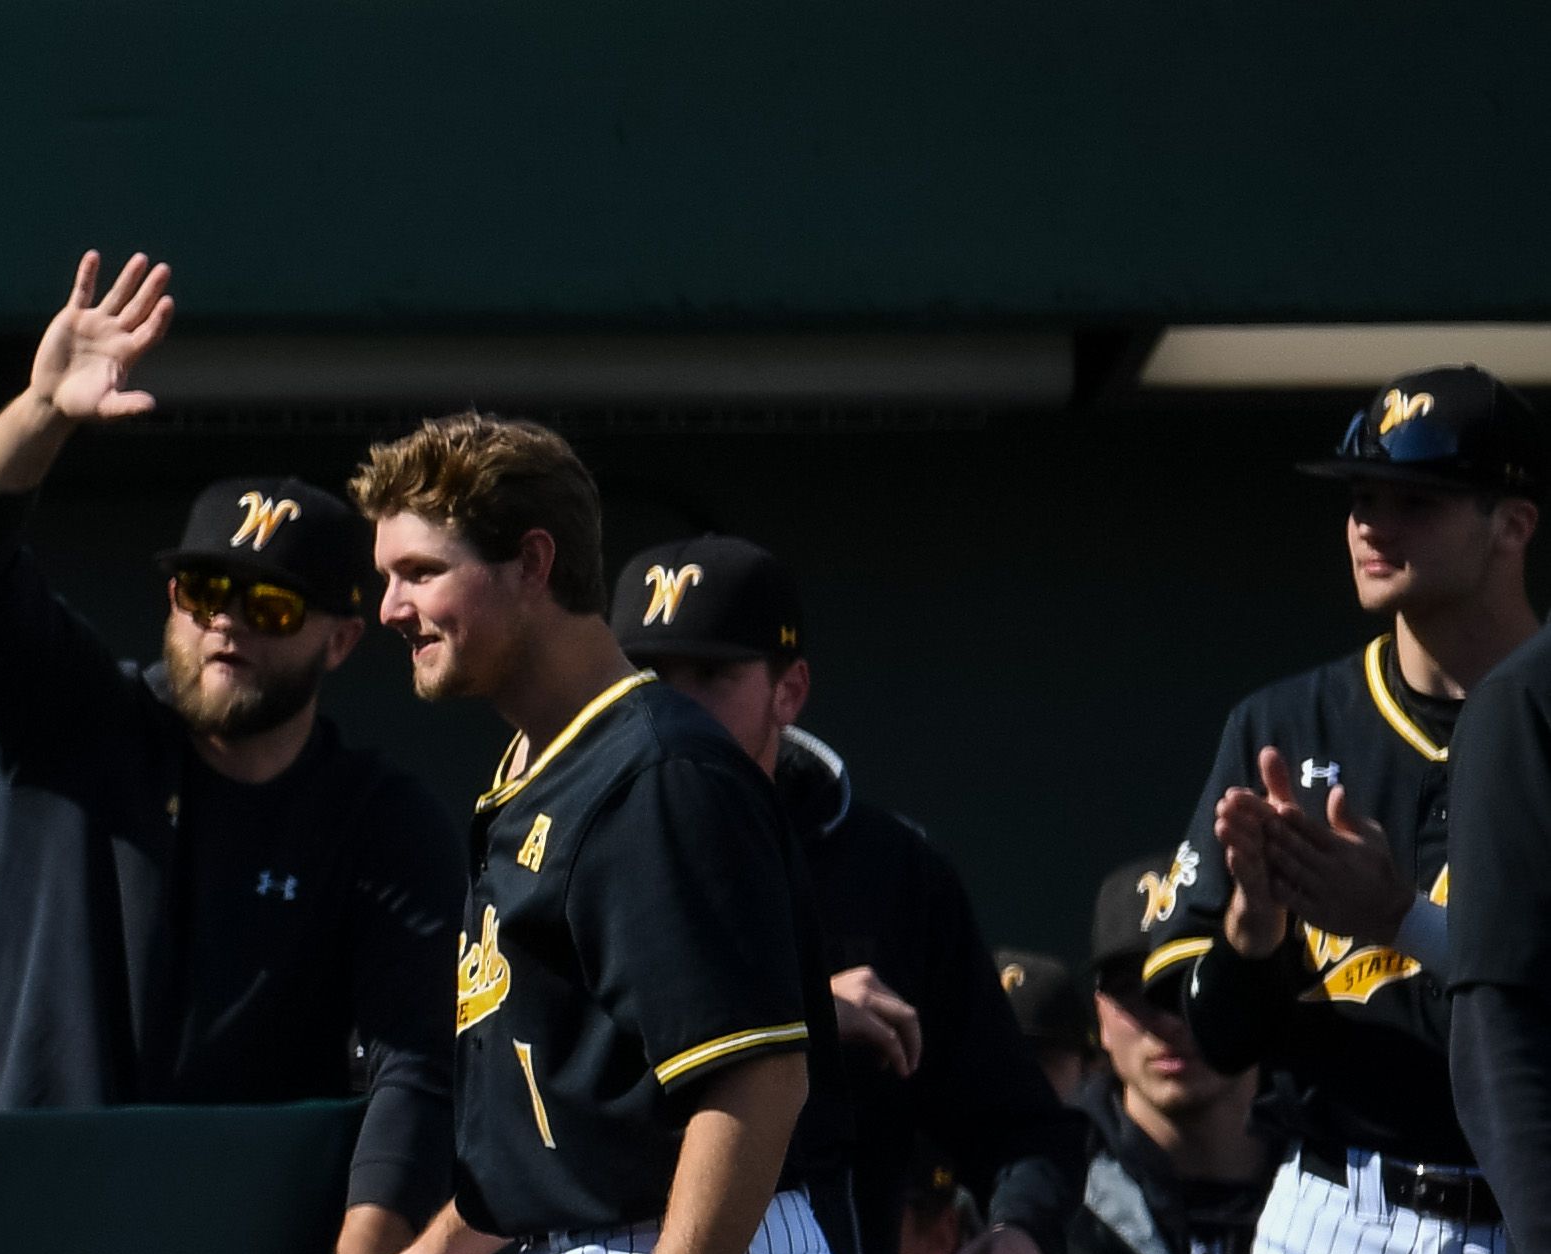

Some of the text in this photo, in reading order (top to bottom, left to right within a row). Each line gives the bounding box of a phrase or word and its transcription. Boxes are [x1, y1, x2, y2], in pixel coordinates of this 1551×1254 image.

[229, 490, 302, 552] W
[642, 563, 704, 627] W
[517, 812, 553, 873] A
